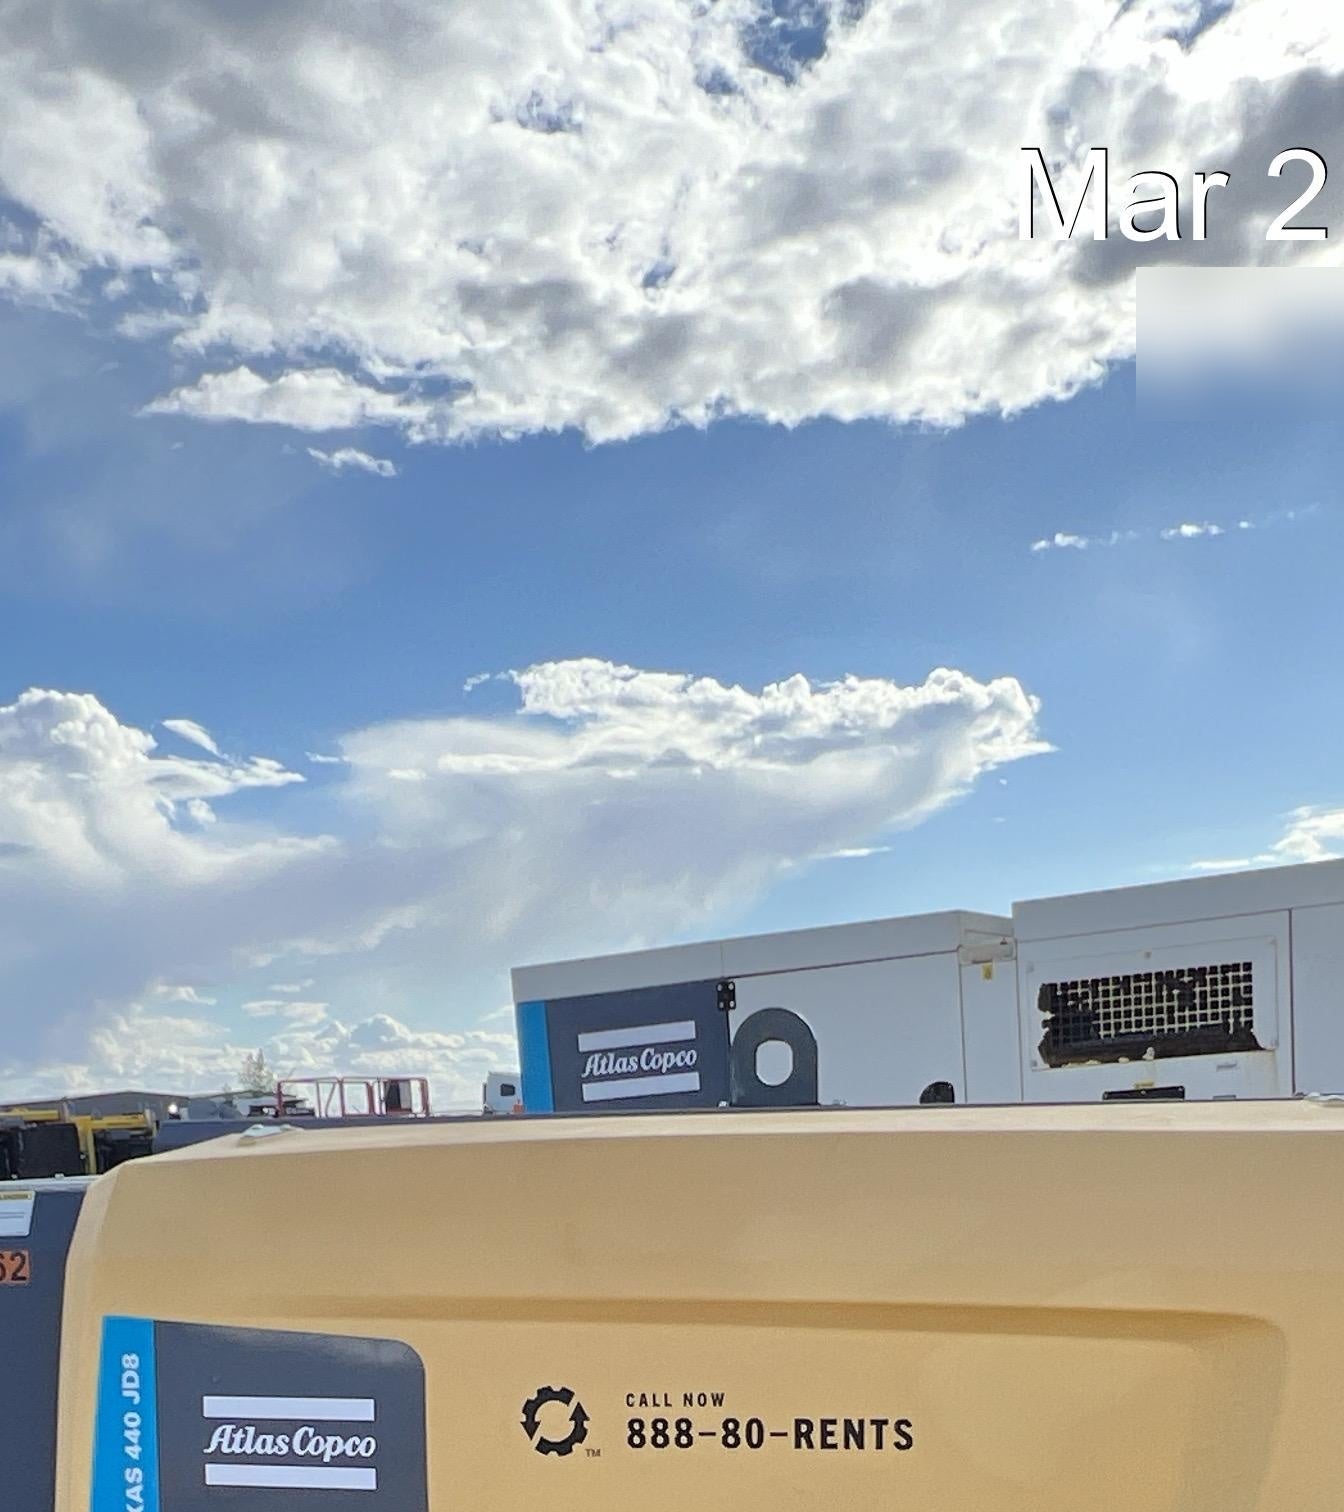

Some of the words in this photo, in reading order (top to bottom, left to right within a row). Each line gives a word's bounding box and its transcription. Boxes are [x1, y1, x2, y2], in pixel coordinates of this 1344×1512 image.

[581, 1053, 638, 1077] Atlas
[640, 1048, 697, 1073] Copco
[121, 1353, 141, 1405] JD8
[625, 1392, 673, 1408] CALL
[683, 1392, 726, 1408] NOW
[122, 1411, 143, 1461] 440
[203, 1424, 290, 1456] Atlas
[292, 1426, 377, 1463] Copco
[626, 1417, 915, 1451] 888-80-RENTS
